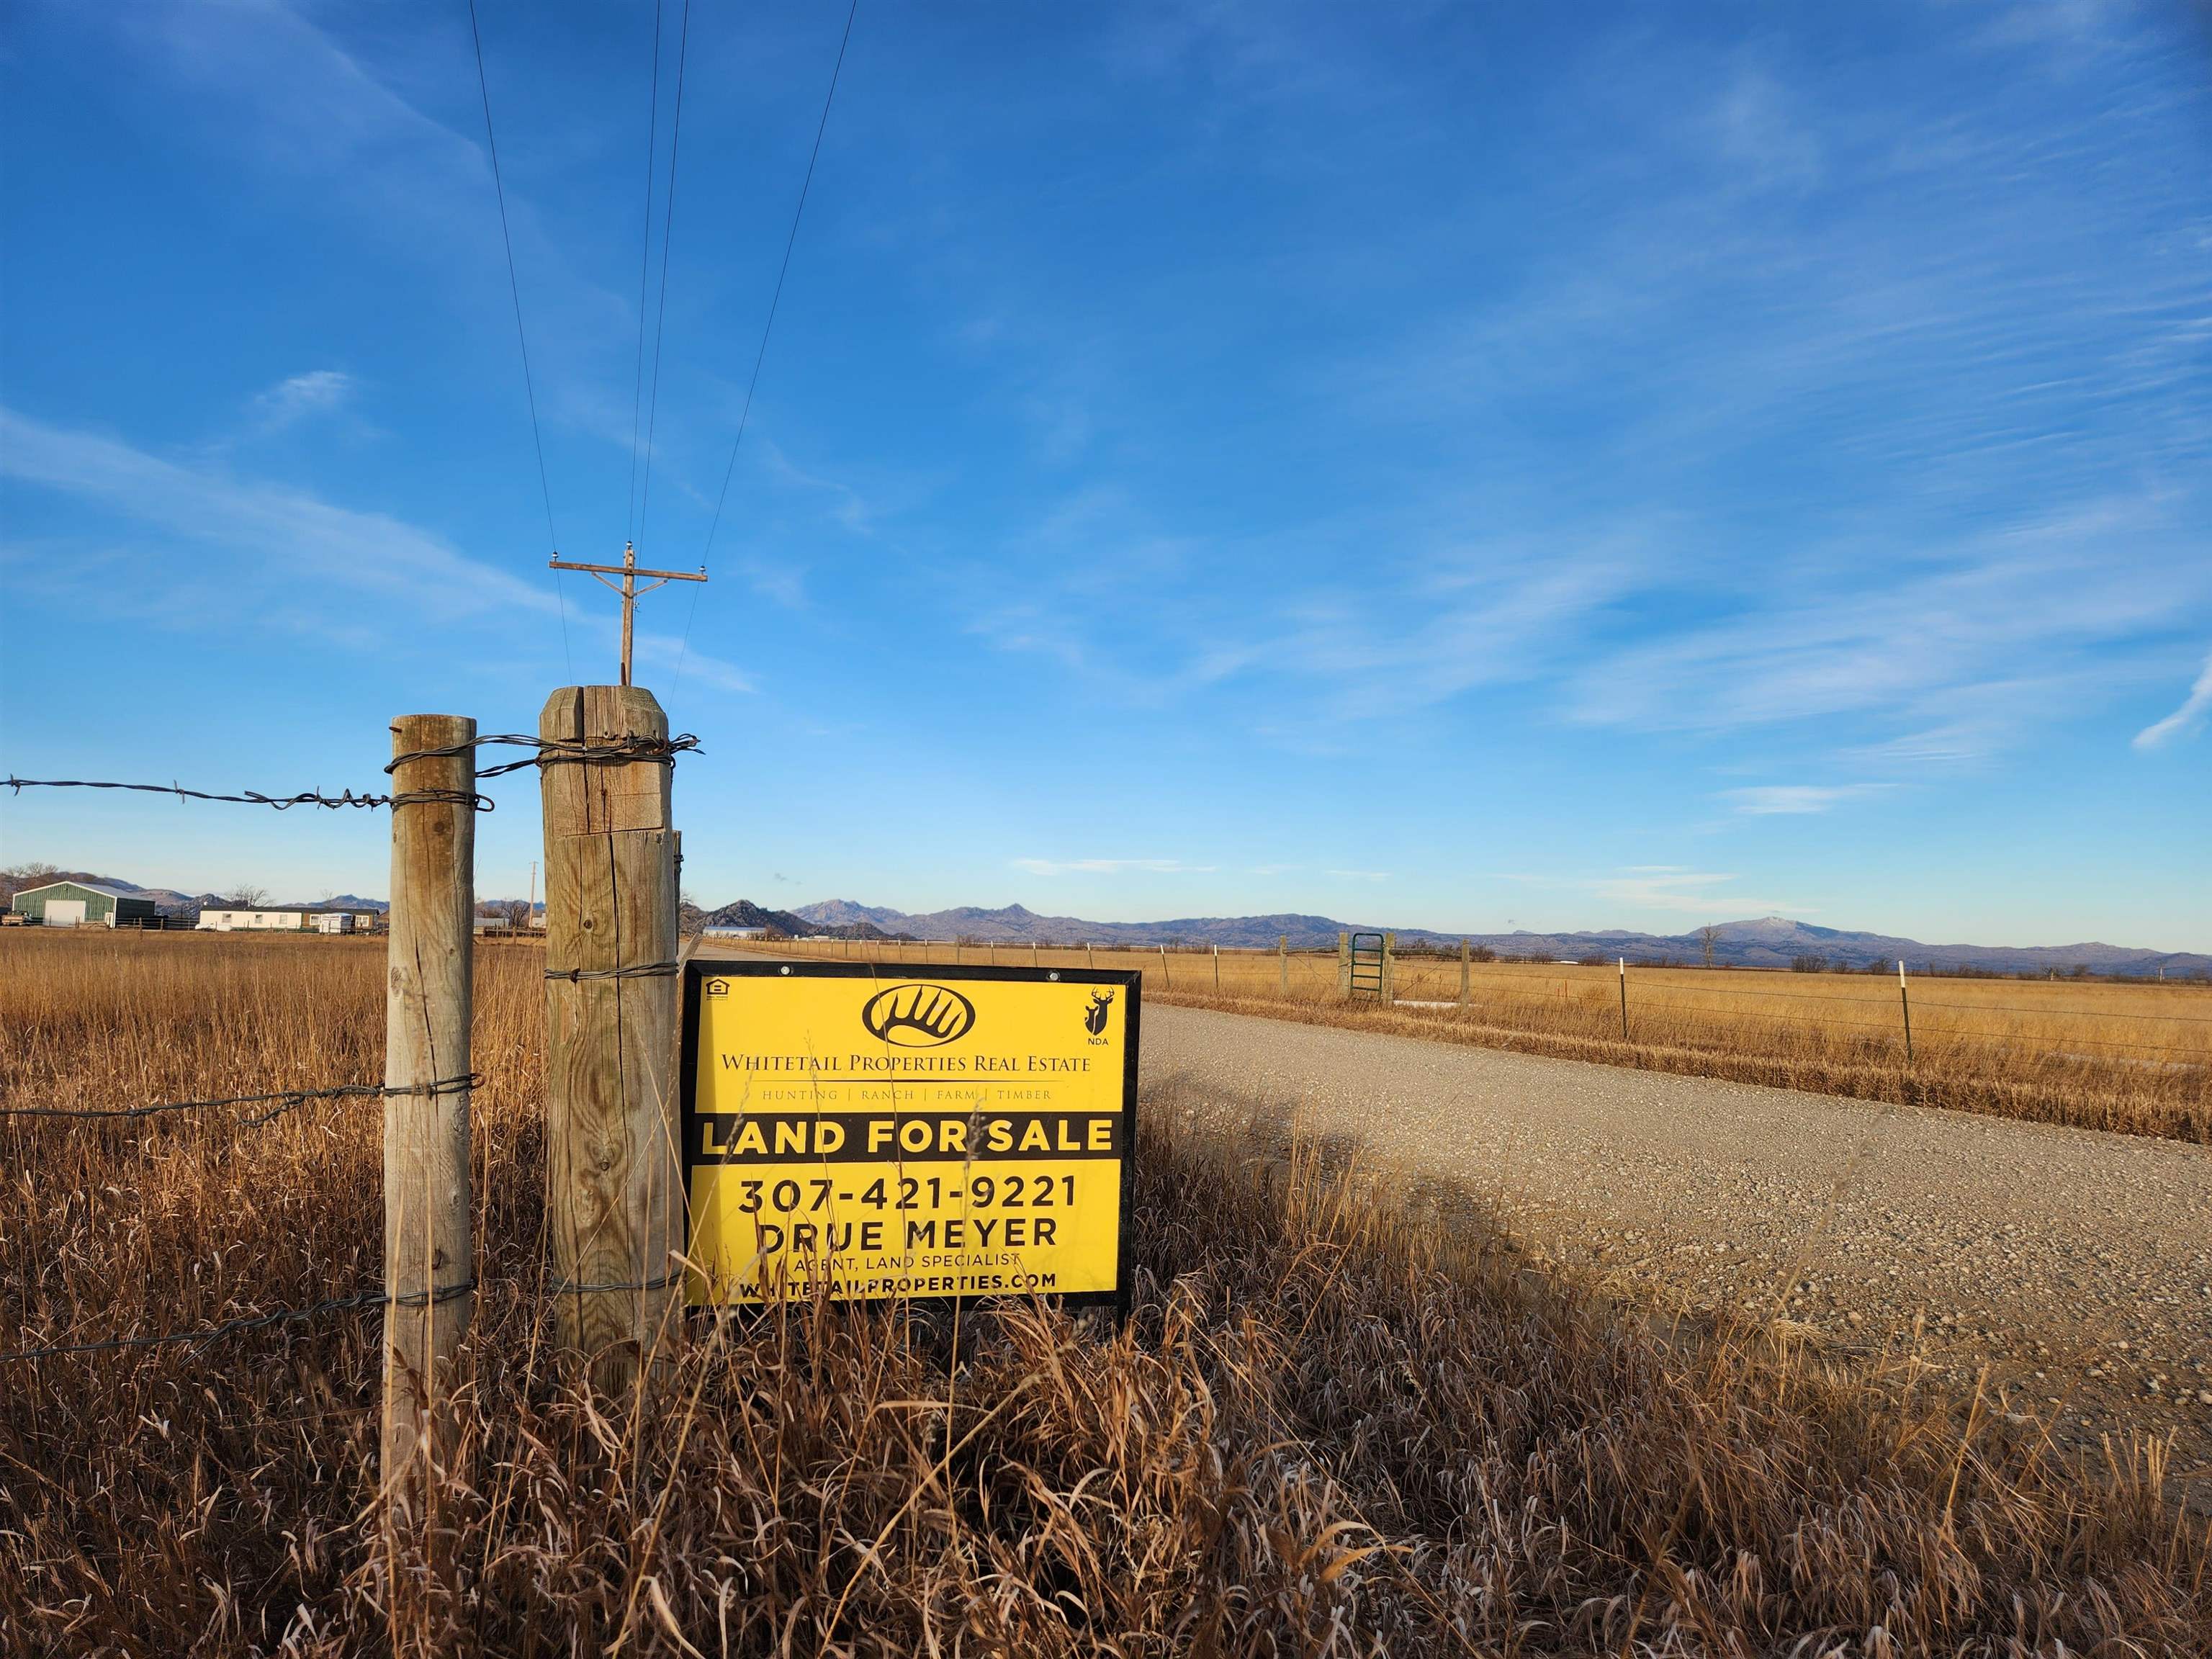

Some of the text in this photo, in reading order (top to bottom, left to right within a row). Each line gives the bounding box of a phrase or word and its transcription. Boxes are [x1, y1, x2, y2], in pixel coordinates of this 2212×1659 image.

[850, 1054, 966, 1071] PROPERTIES
[974, 1055, 1020, 1071] REAL
[1028, 1056, 1091, 1072] ESTATE
[763, 1090, 1051, 1100] HUNTING RANCH FARM TIMBER
[702, 1119, 1112, 1155] LAND FOR SALE
[738, 1175, 1074, 1214] 307-421-9221
[757, 1218, 1057, 1254] DRUE MEYER
[866, 1256, 914, 1270] LAND
[922, 1253, 1020, 1267] SPECIALIST
